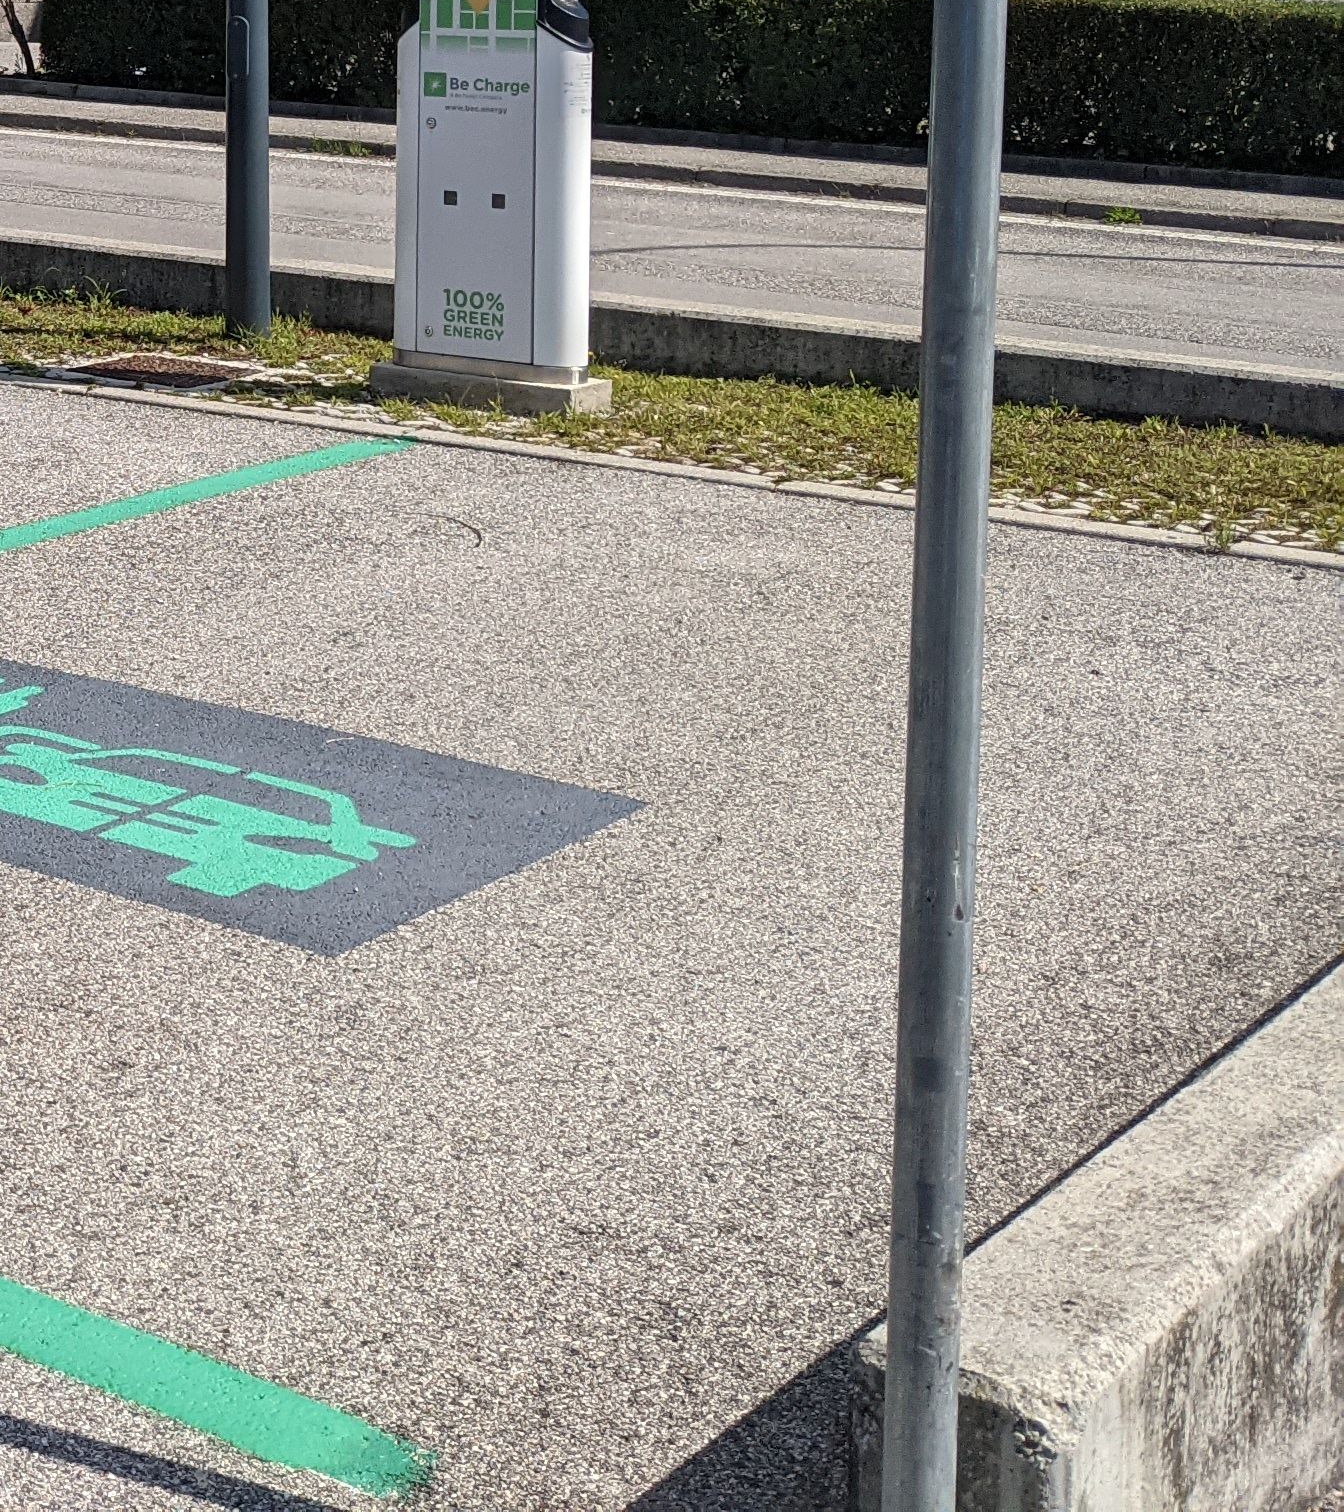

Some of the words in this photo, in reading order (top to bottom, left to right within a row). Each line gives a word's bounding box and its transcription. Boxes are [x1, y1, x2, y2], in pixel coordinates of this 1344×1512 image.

[449, 77, 469, 91] Be
[473, 77, 530, 97] Charge
[443, 288, 505, 312] 100%
[443, 308, 504, 327] GREEN
[443, 324, 505, 342] ENERGY
